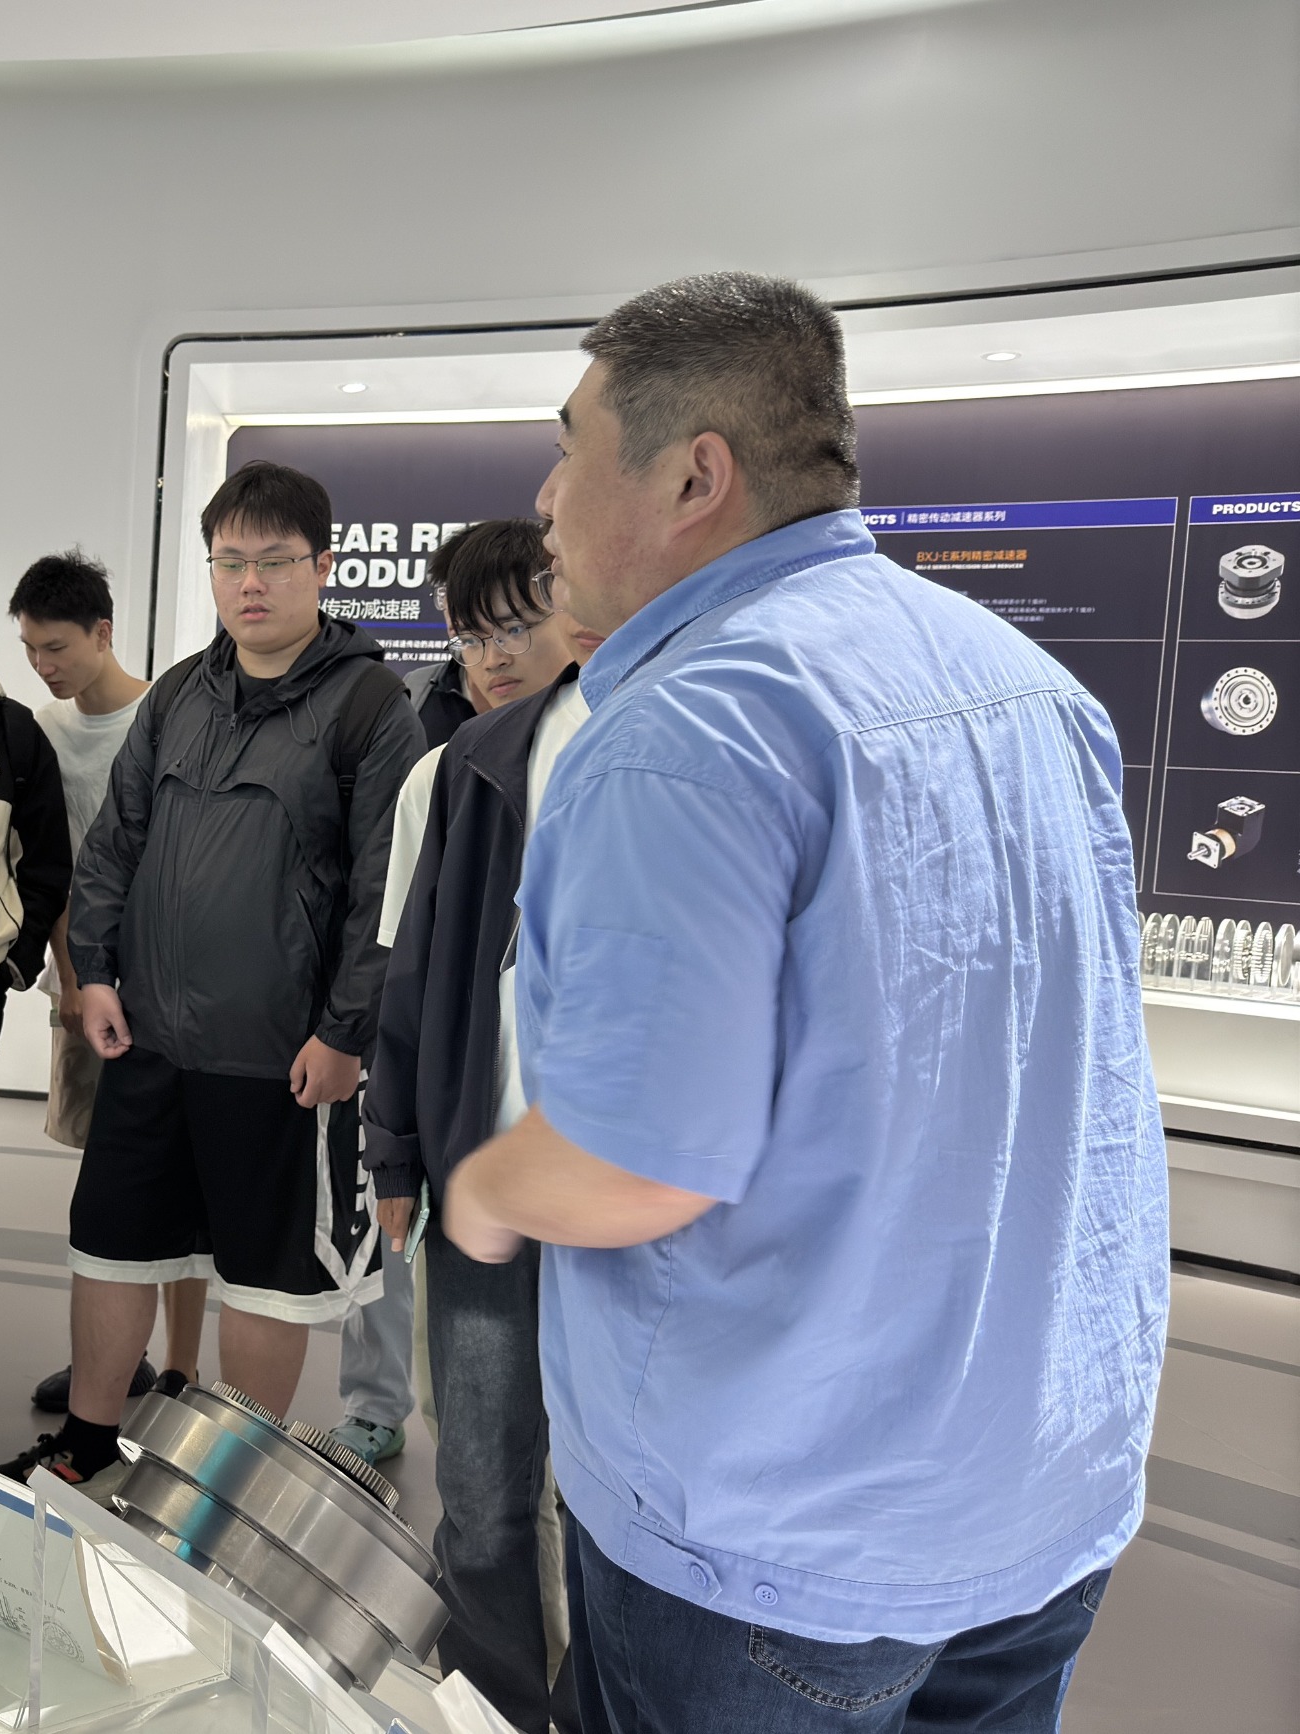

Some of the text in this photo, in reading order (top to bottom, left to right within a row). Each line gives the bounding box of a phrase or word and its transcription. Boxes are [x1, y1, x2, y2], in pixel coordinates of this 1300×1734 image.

[1212, 501, 1300, 515] PRODUCTS
[907, 510, 1006, 524] 精密传动减速器系列
